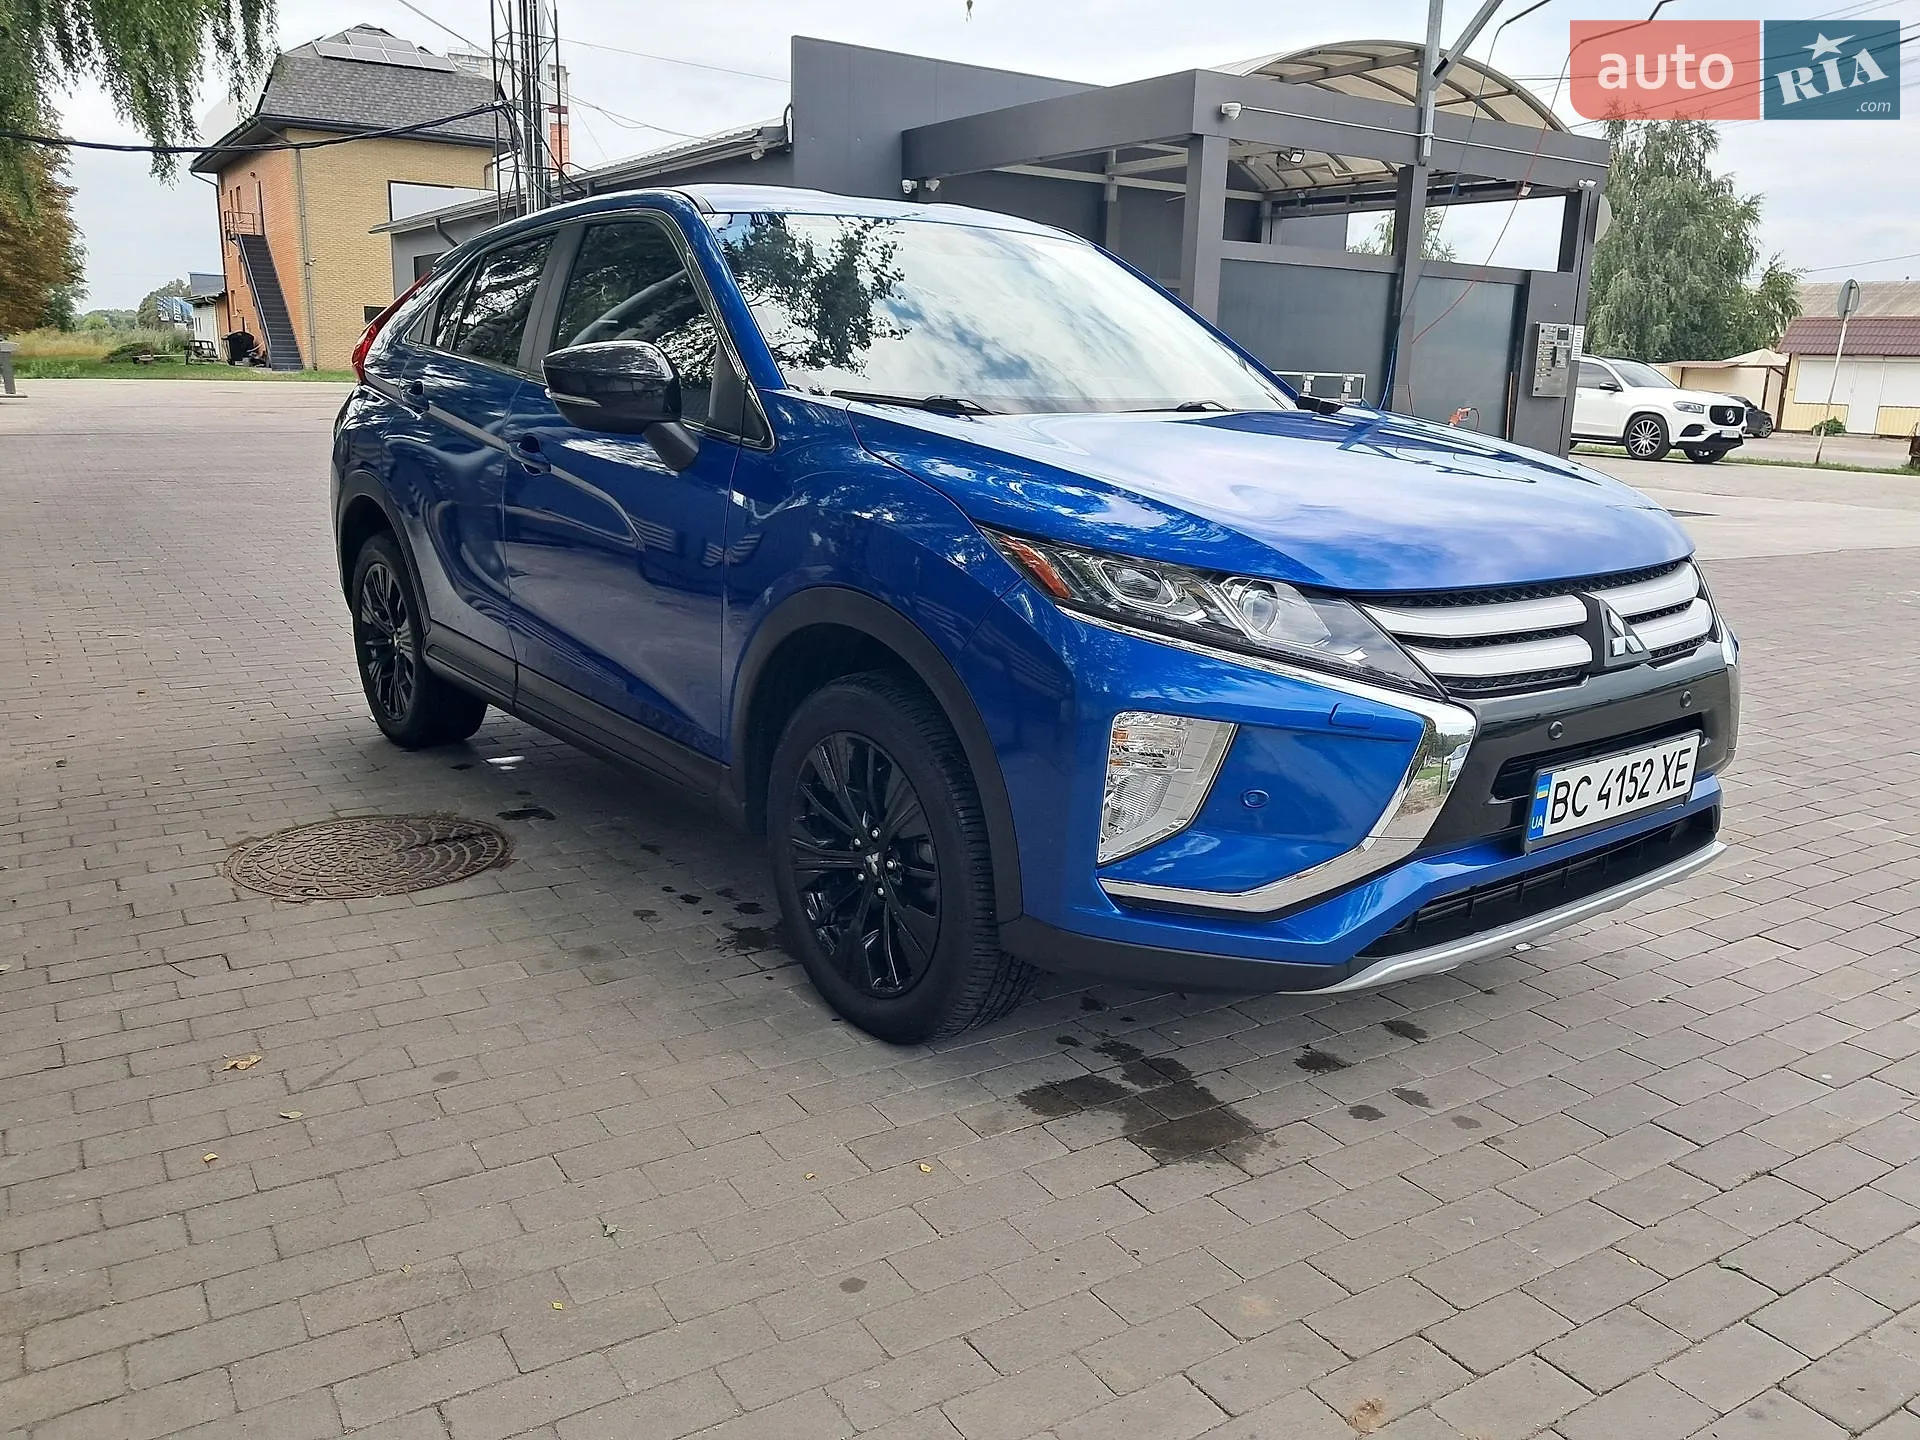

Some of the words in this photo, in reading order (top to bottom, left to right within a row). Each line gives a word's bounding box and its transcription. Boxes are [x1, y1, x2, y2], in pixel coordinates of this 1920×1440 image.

[1550, 775, 1592, 825] BC
[1597, 758, 1655, 810] 4152
[1656, 747, 1692, 795] XE
[1531, 815, 1544, 830] UA
